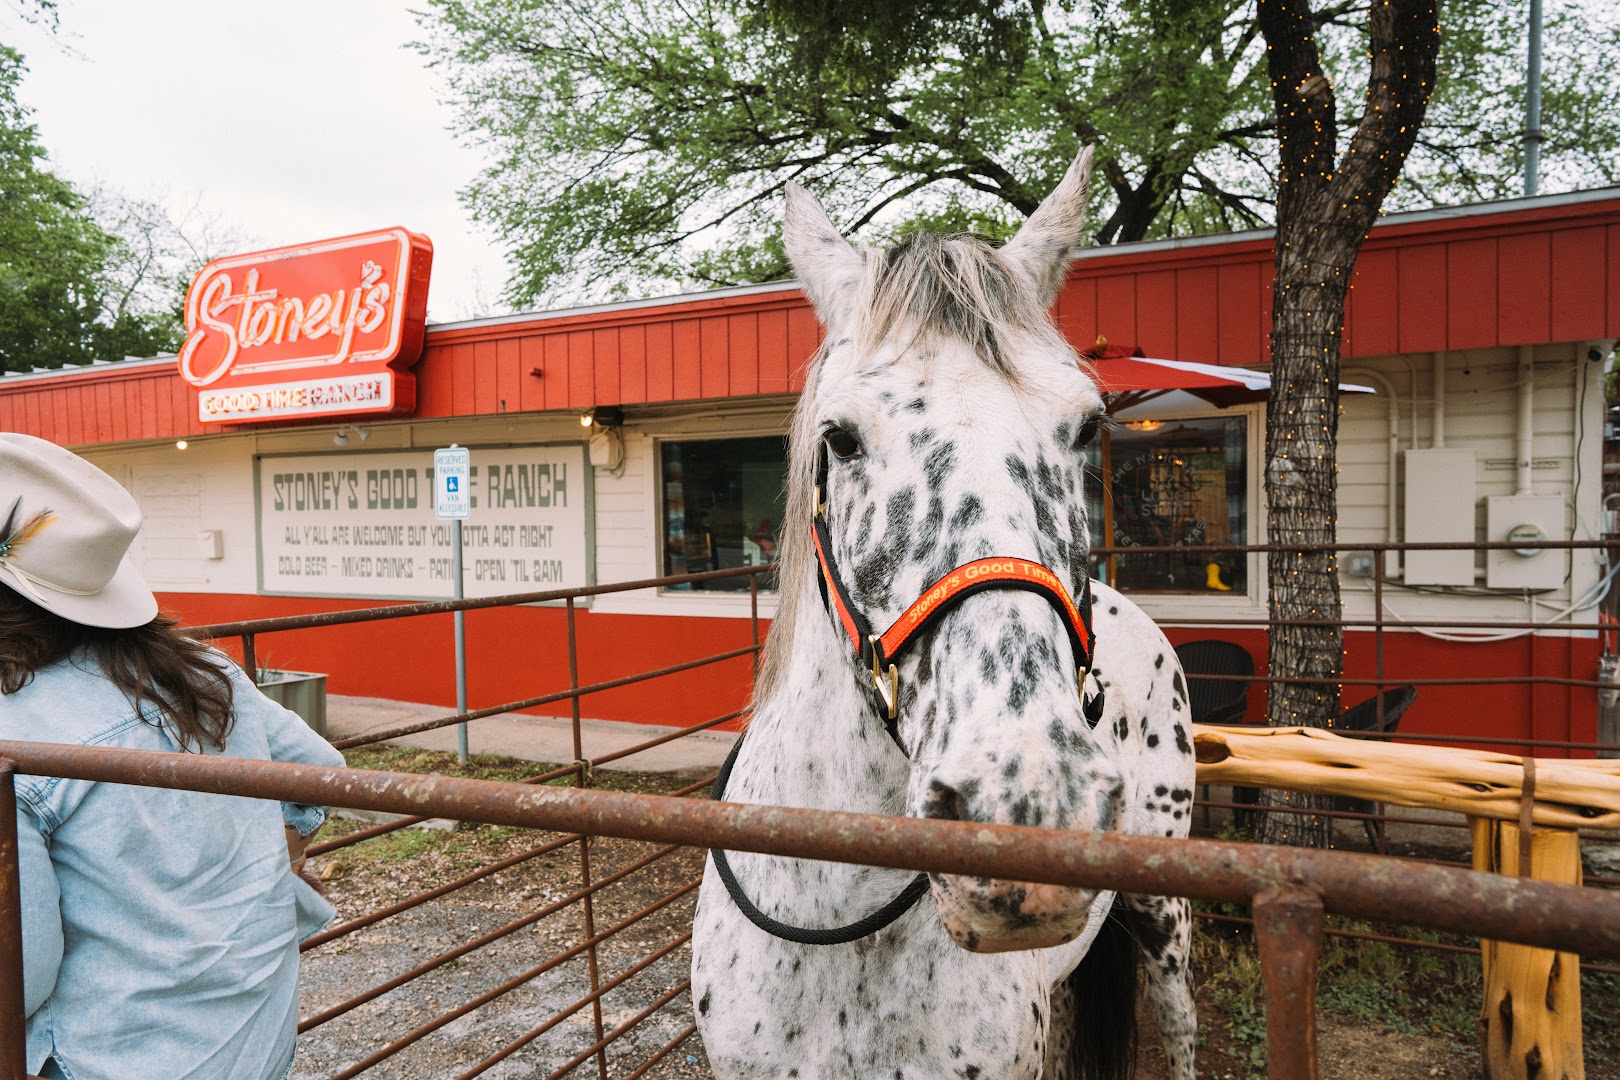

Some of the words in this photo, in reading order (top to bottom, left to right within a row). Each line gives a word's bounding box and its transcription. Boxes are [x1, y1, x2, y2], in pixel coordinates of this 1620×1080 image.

[177, 260, 390, 386] Stoney's
[200, 391, 260, 414] GOOD
[261, 388, 307, 409] TIME
[309, 380, 382, 406] RANCH
[437, 455, 466, 464] RESERVED
[440, 466, 464, 474] PARKING
[273, 470, 358, 512] STONEY'S
[366, 468, 418, 510] GOOD
[426, 466, 478, 509] TE
[488, 462, 568, 509] RANCH
[439, 503, 467, 512] ACCESSIBLE
[285, 526, 301, 545] ALL
[304, 526, 329, 545] Y'ALL
[332, 526, 350, 546] ARE
[352, 526, 404, 546] WELCOME
[408, 526, 427, 546] BUT
[430, 526, 450, 547] YOU
[462, 526, 489, 548] OTTA
[493, 526, 516, 548] ACT
[520, 525, 554, 548] RIGHT
[278, 556, 301, 576] COLD
[305, 556, 328, 576] BEER
[342, 556, 372, 577] MIXED
[376, 557, 414, 578] DRINKS
[430, 558, 454, 580] PATI
[475, 559, 506, 582] OPEN
[510, 559, 530, 582] 'TIL
[534, 560, 563, 584] 2AM
[908, 577, 961, 624] Stoney's
[964, 562, 1016, 580] Good
[1019, 563, 1058, 587] Time
